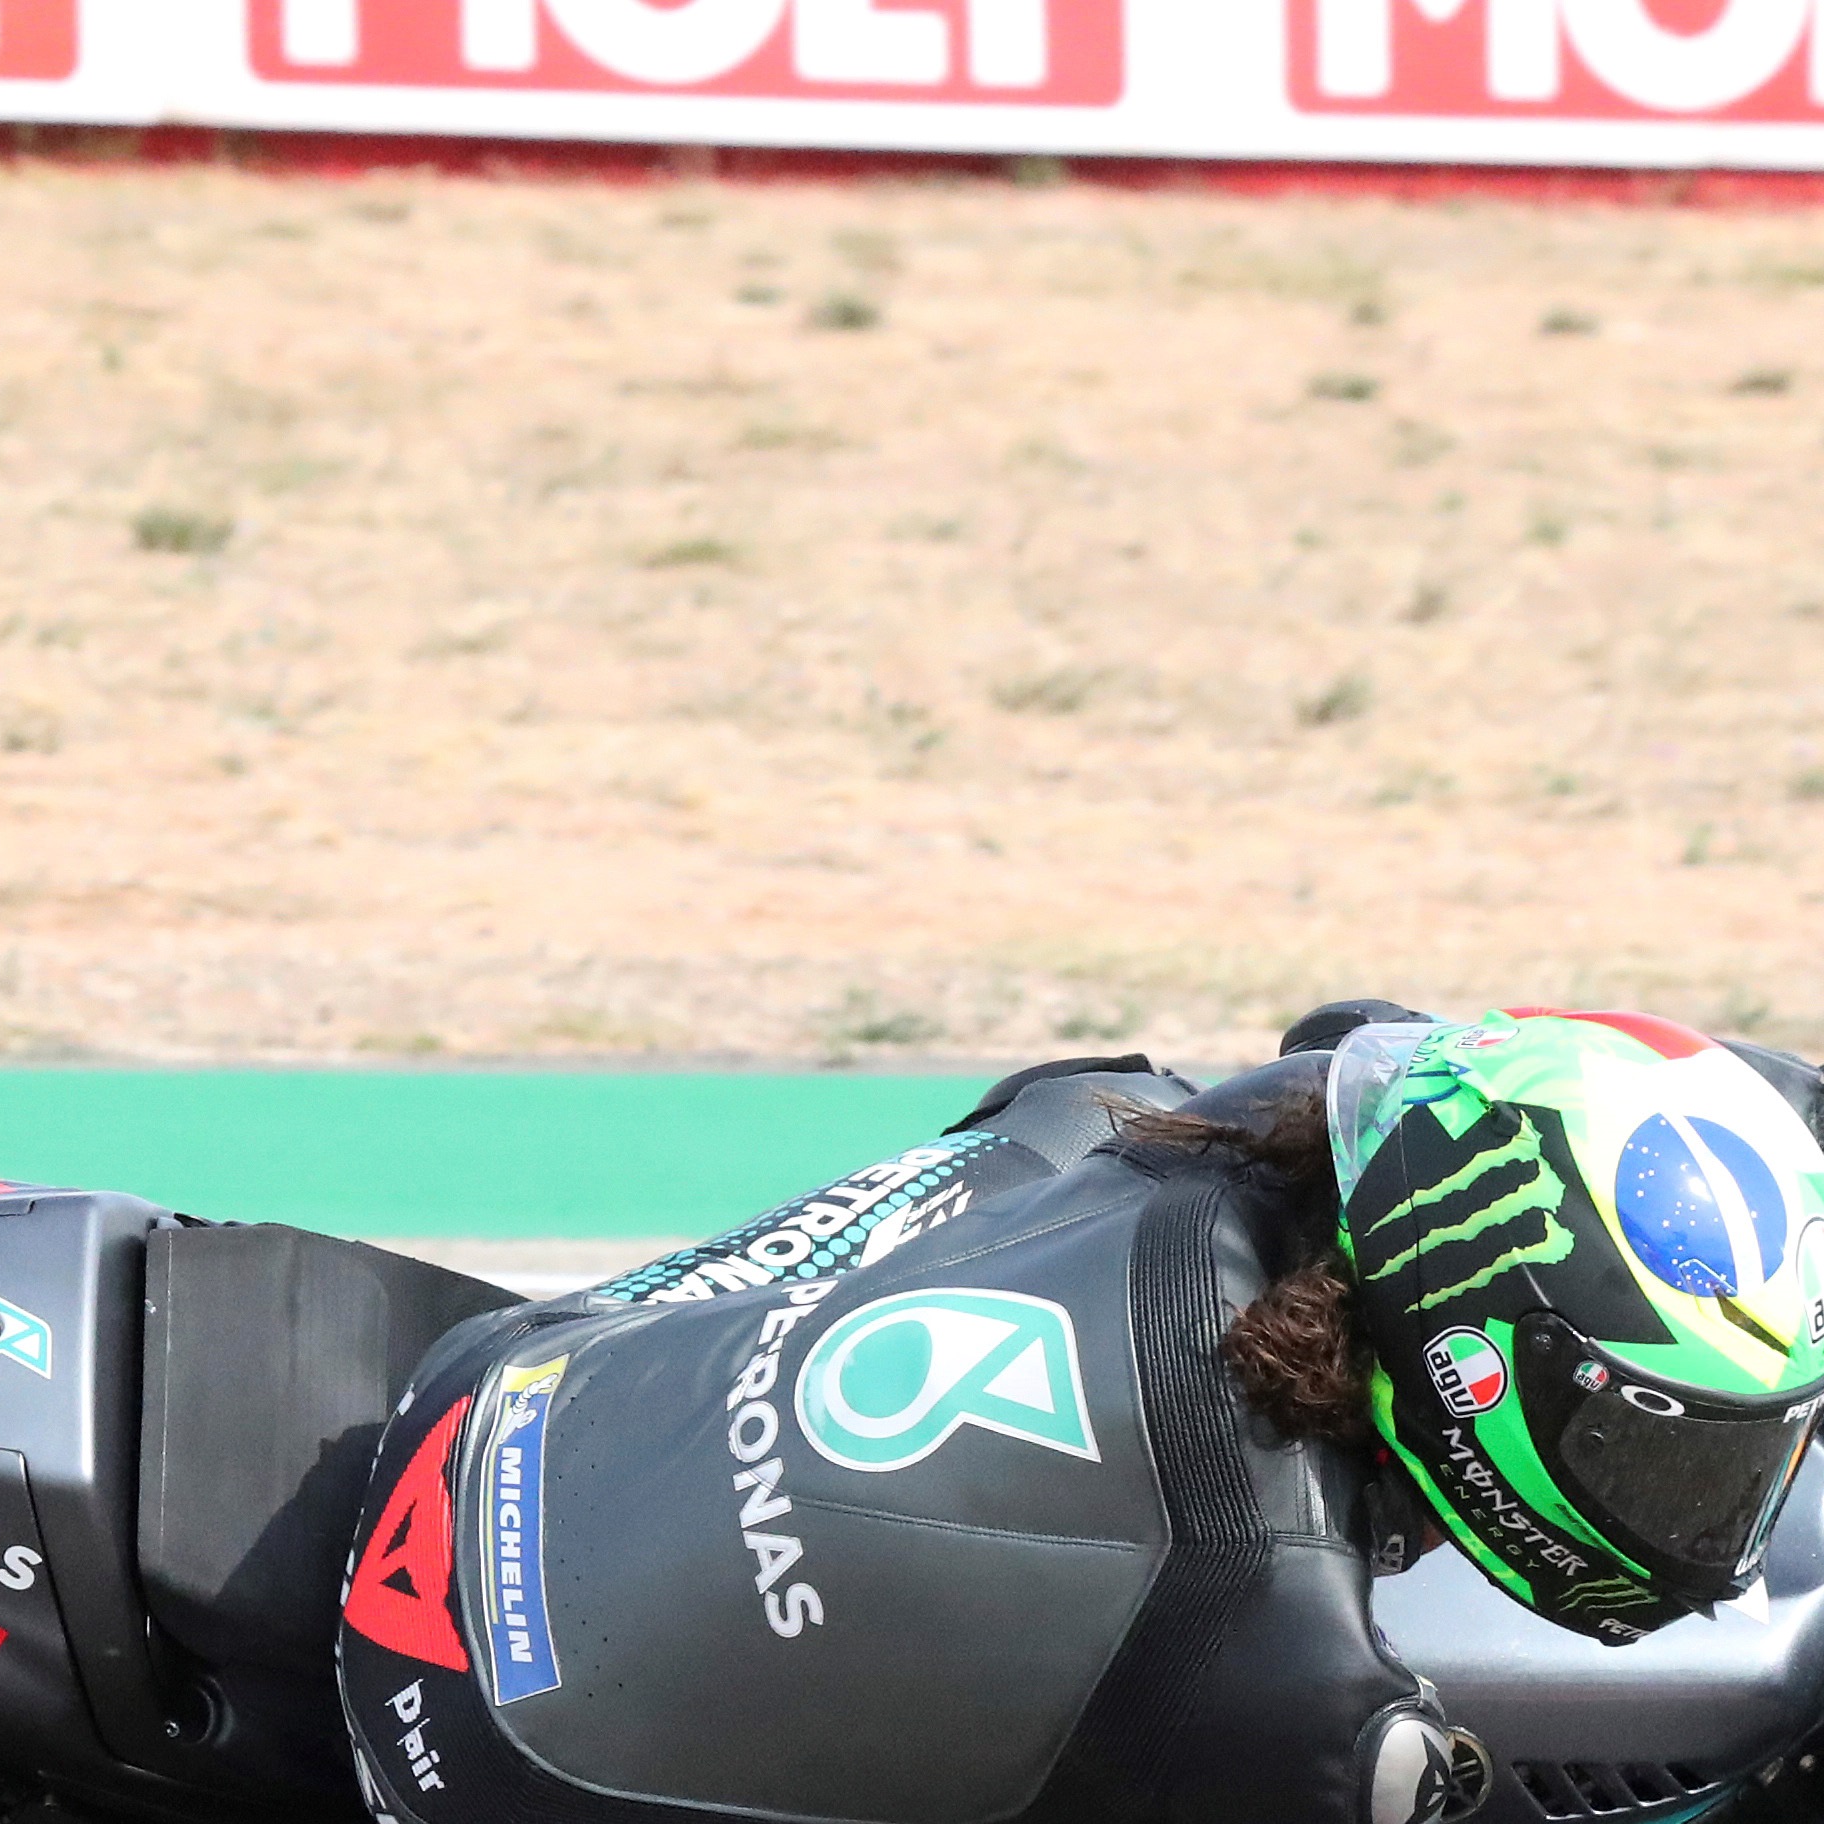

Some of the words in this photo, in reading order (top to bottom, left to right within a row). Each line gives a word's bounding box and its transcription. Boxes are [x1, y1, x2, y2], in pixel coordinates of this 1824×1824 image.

[646, 1146, 952, 1304] PETRONA
[1429, 1350, 1478, 1413] agv
[497, 1445, 535, 1664] MICHELIN
[1441, 1464, 1540, 1570] ENERGY
[1442, 1426, 1590, 1577] MONSTER
